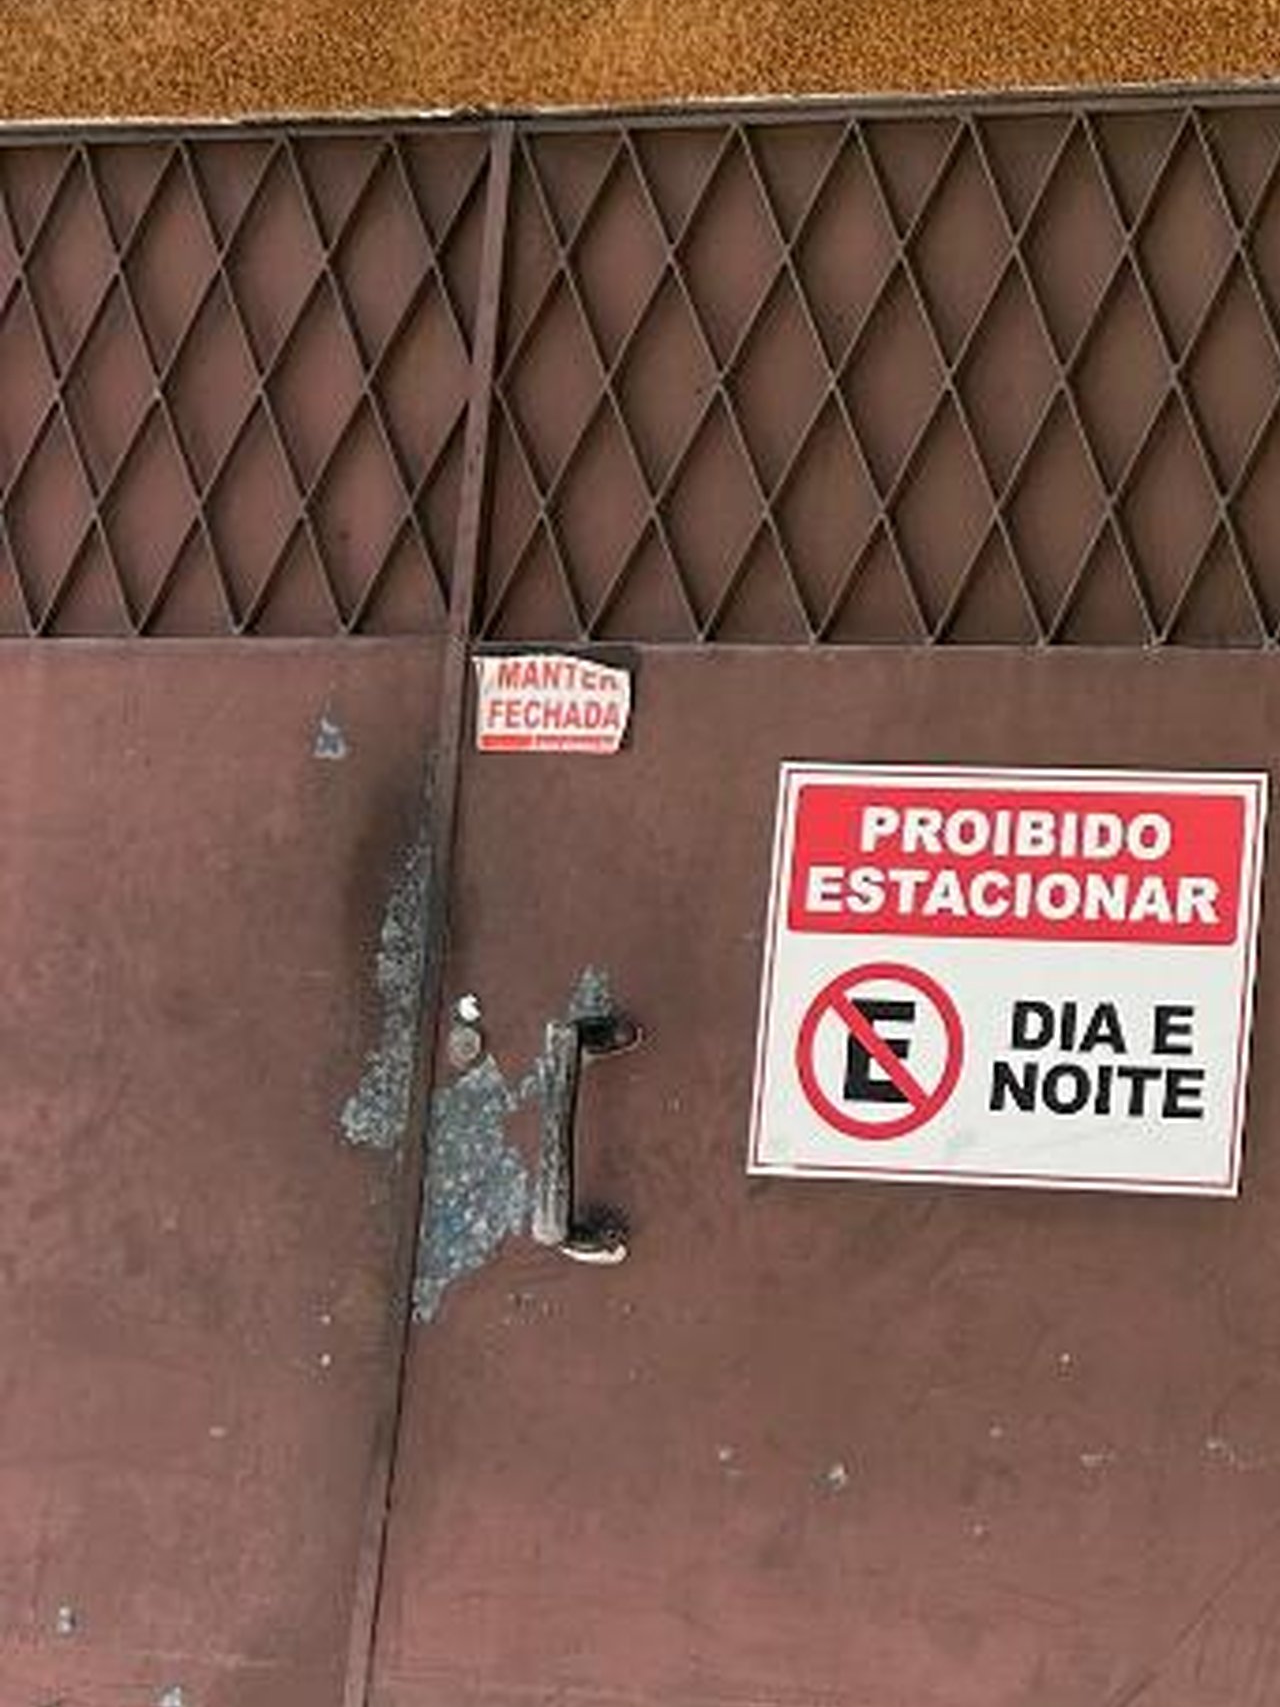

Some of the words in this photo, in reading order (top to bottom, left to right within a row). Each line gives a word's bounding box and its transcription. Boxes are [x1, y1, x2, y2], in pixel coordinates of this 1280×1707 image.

[487, 699, 620, 729] FECHADA
[859, 805, 1173, 861] PROIBIDO
[804, 865, 1220, 925] ESTACIONAR
[1010, 1000, 1128, 1054] DIA
[1151, 1004, 1195, 1056] E
[988, 1061, 1206, 1121] NOITE
